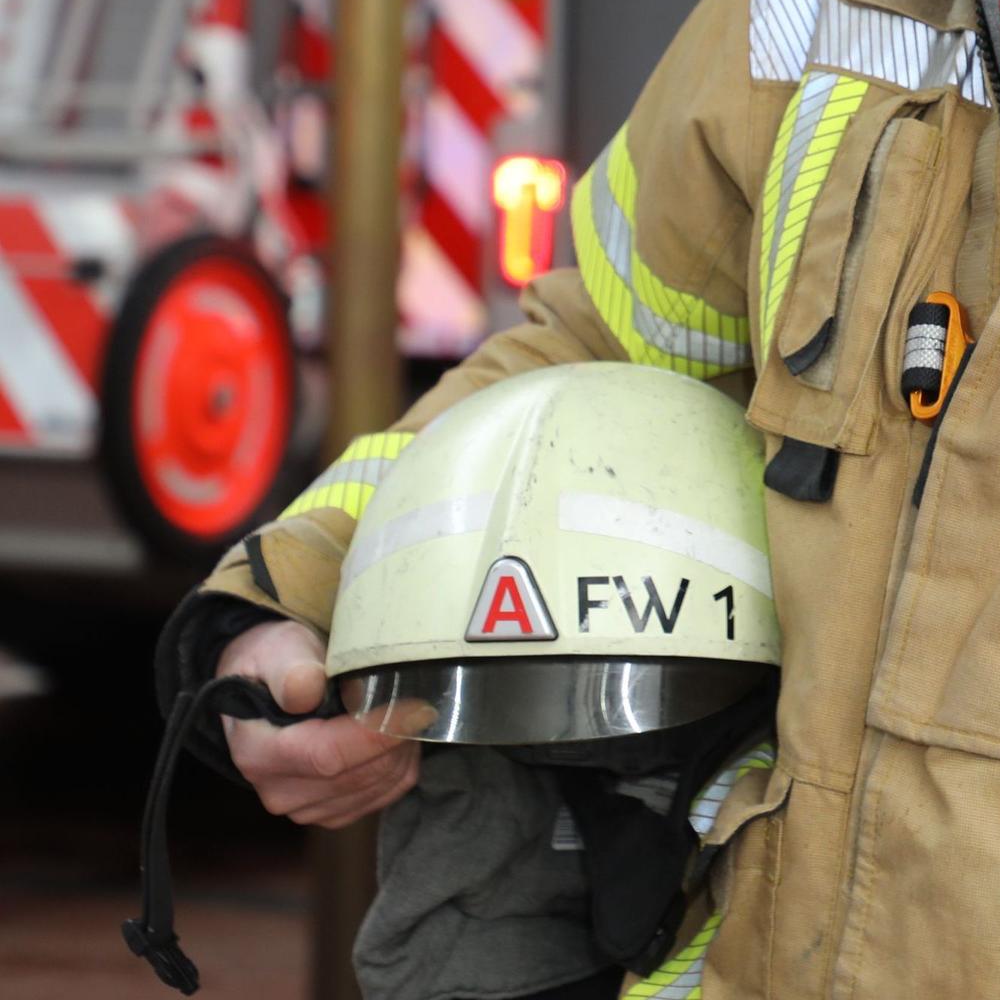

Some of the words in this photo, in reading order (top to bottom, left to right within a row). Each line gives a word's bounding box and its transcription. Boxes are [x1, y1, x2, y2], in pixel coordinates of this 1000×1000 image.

[481, 575, 534, 634] A
[576, 575, 691, 634] FW
[713, 584, 735, 641] 1
